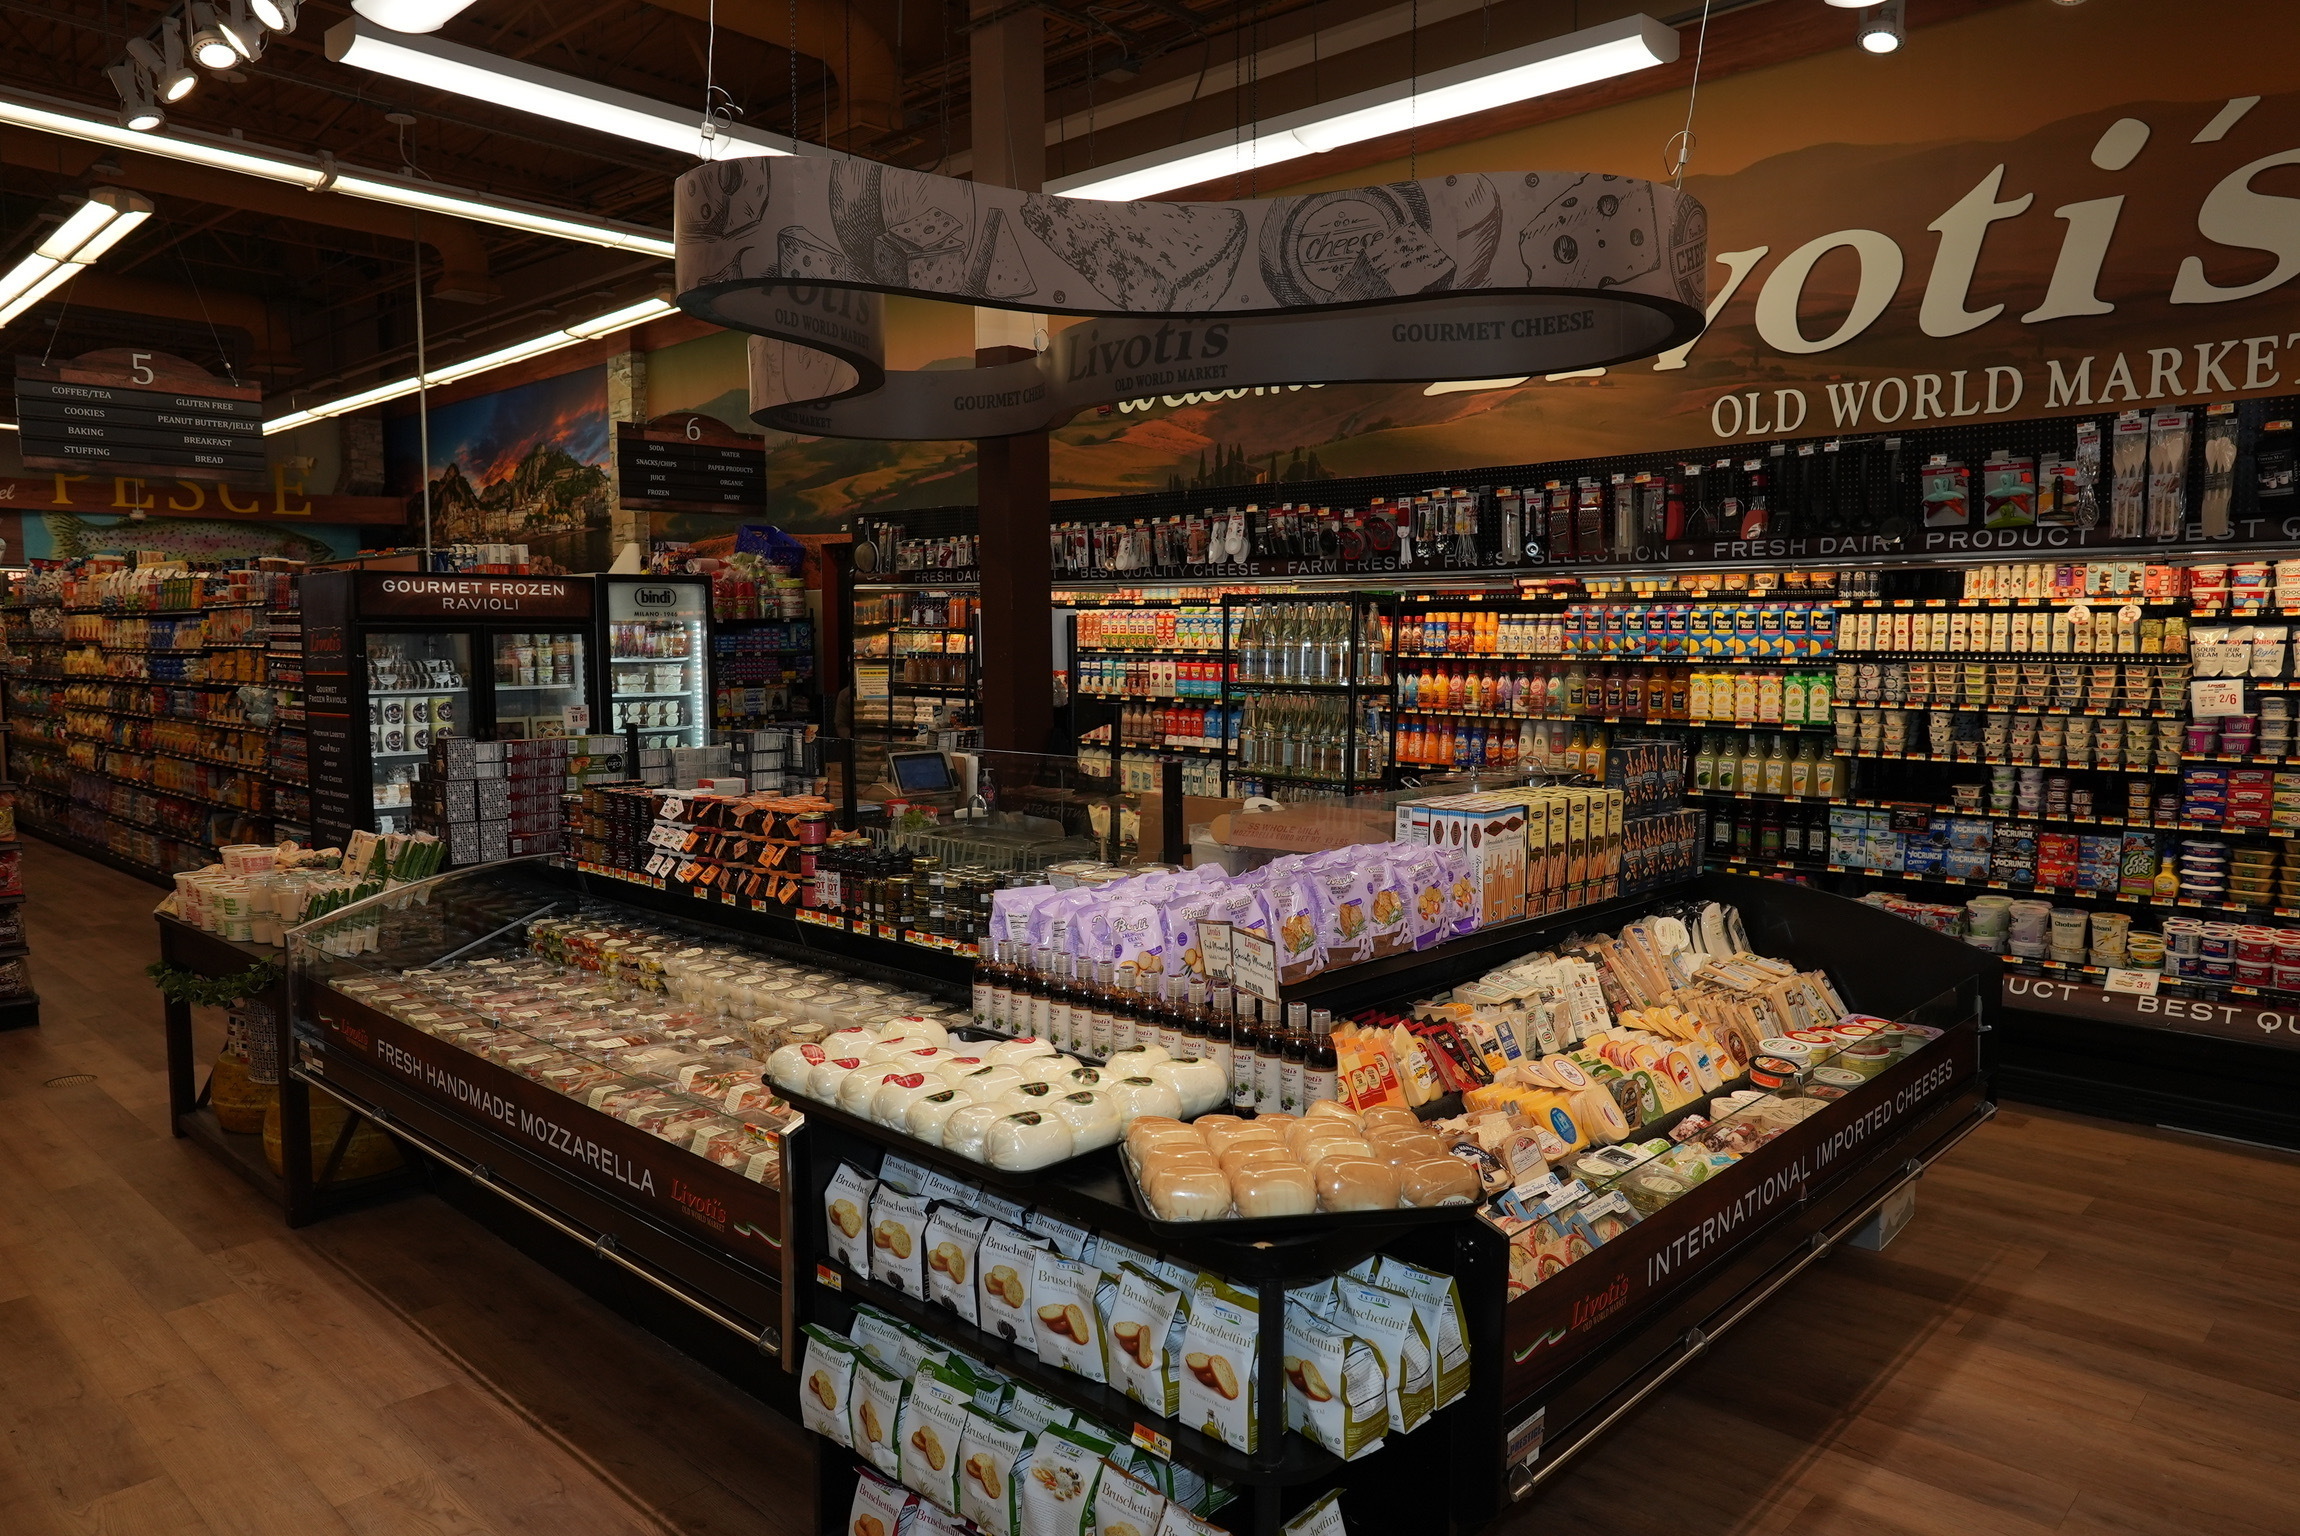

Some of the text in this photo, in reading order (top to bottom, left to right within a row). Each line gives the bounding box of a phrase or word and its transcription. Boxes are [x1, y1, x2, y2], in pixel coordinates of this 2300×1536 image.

[775, 308, 870, 350] OLD WORLD MARKET
[1391, 310, 1595, 343] GOURMET CHEESE
[132, 353, 154, 385] 5
[1115, 364, 1228, 393] OLD WORLD MARKET
[52, 386, 111, 399] COFFEE/TEA
[176, 398, 233, 411] GLUTEN FREE
[954, 390, 1021, 411] GOURMET
[1711, 388, 1807, 438] OLD
[1825, 366, 2024, 429] WORLD
[64, 407, 105, 417] COOKIES
[158, 415, 254, 431] PEANUT BUTTER/JELLY
[799, 414, 833, 429] MARKET
[68, 426, 103, 437] BAKING
[686, 417, 700, 441] 6
[64, 446, 110, 457] STUFFING
[183, 436, 232, 447] BREAKFAST
[195, 455, 223, 464] BREAD
[636, 459, 677, 468] SNACKS/CHIPS
[720, 479, 743, 487] ORGANIC
[1714, 539, 1807, 559] FRESH
[1925, 528, 2096, 549] PRODUCT
[915, 571, 952, 583] FRESH
[1193, 563, 1260, 577] CHEESE
[1287, 558, 1411, 575] FARM FRESH
[382, 580, 565, 596] GOURMET FROZEN
[641, 589, 671, 604] bindi
[443, 598, 519, 610] RAVIOLI
[2253, 648, 2280, 657] Light
[2254, 638, 2277, 646] Daisy
[1262, 824, 1296, 833] WHOLE
[2054, 920, 2082, 928] Chobani
[2137, 995, 2243, 1026] BEST
[377, 1039, 656, 1197] FRESH HANDMADE MOZZARELLA
[885, 1155, 926, 1181] Bruschettini
[1647, 1057, 1955, 1287] INTERNATIONAL IMPORTED CHEESES
[929, 1176, 976, 1202] Bruschettini
[682, 1205, 725, 1233] OLD WORLD MARKET
[933, 1213, 981, 1241] Bruschettini
[1035, 1215, 1084, 1243] Bruschettini
[1100, 1238, 1154, 1266] Bruschettini
[1038, 1269, 1094, 1299] Bruschettini
[1381, 1275, 1445, 1307] Bruschettini
[1122, 1284, 1173, 1321] Bruschettini
[1582, 1296, 1627, 1333] OLD WORLD MARKET
[1215, 1307, 1243, 1324] ASTURI
[1188, 1313, 1254, 1349] Bruschettini
[857, 1368, 898, 1405] Bruschettini
[912, 1393, 965, 1428] Bruschettini
[964, 1421, 1020, 1456] Bruschettini
[1510, 1425, 1544, 1454] PRESTIGE
[859, 1483, 900, 1518] Bruschettini
[1101, 1481, 1160, 1524] Bruschettini
